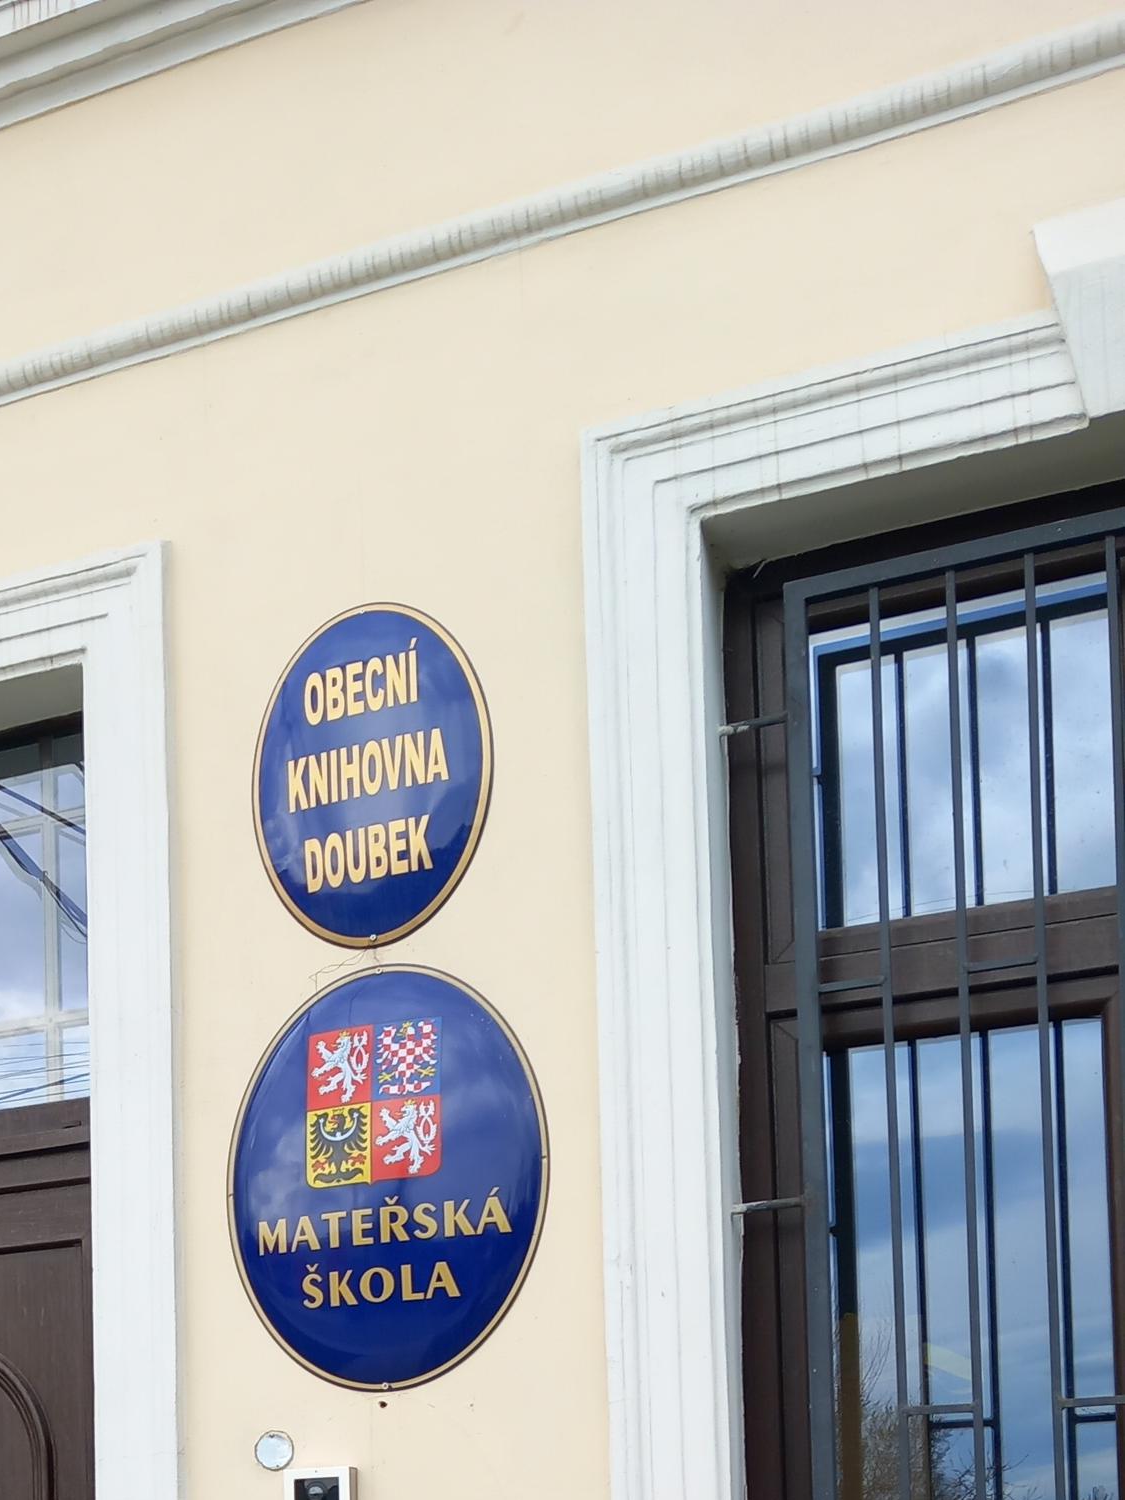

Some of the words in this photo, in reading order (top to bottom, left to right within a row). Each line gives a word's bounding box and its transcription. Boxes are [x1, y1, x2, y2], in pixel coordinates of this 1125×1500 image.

[303, 637, 419, 726] OBECNÍ
[287, 728, 450, 813] KNIHOVNA
[304, 814, 434, 893] DOUBEK
[257, 1187, 513, 1256] MATEŘSKÁ
[301, 1261, 462, 1310] ŠKOLA
